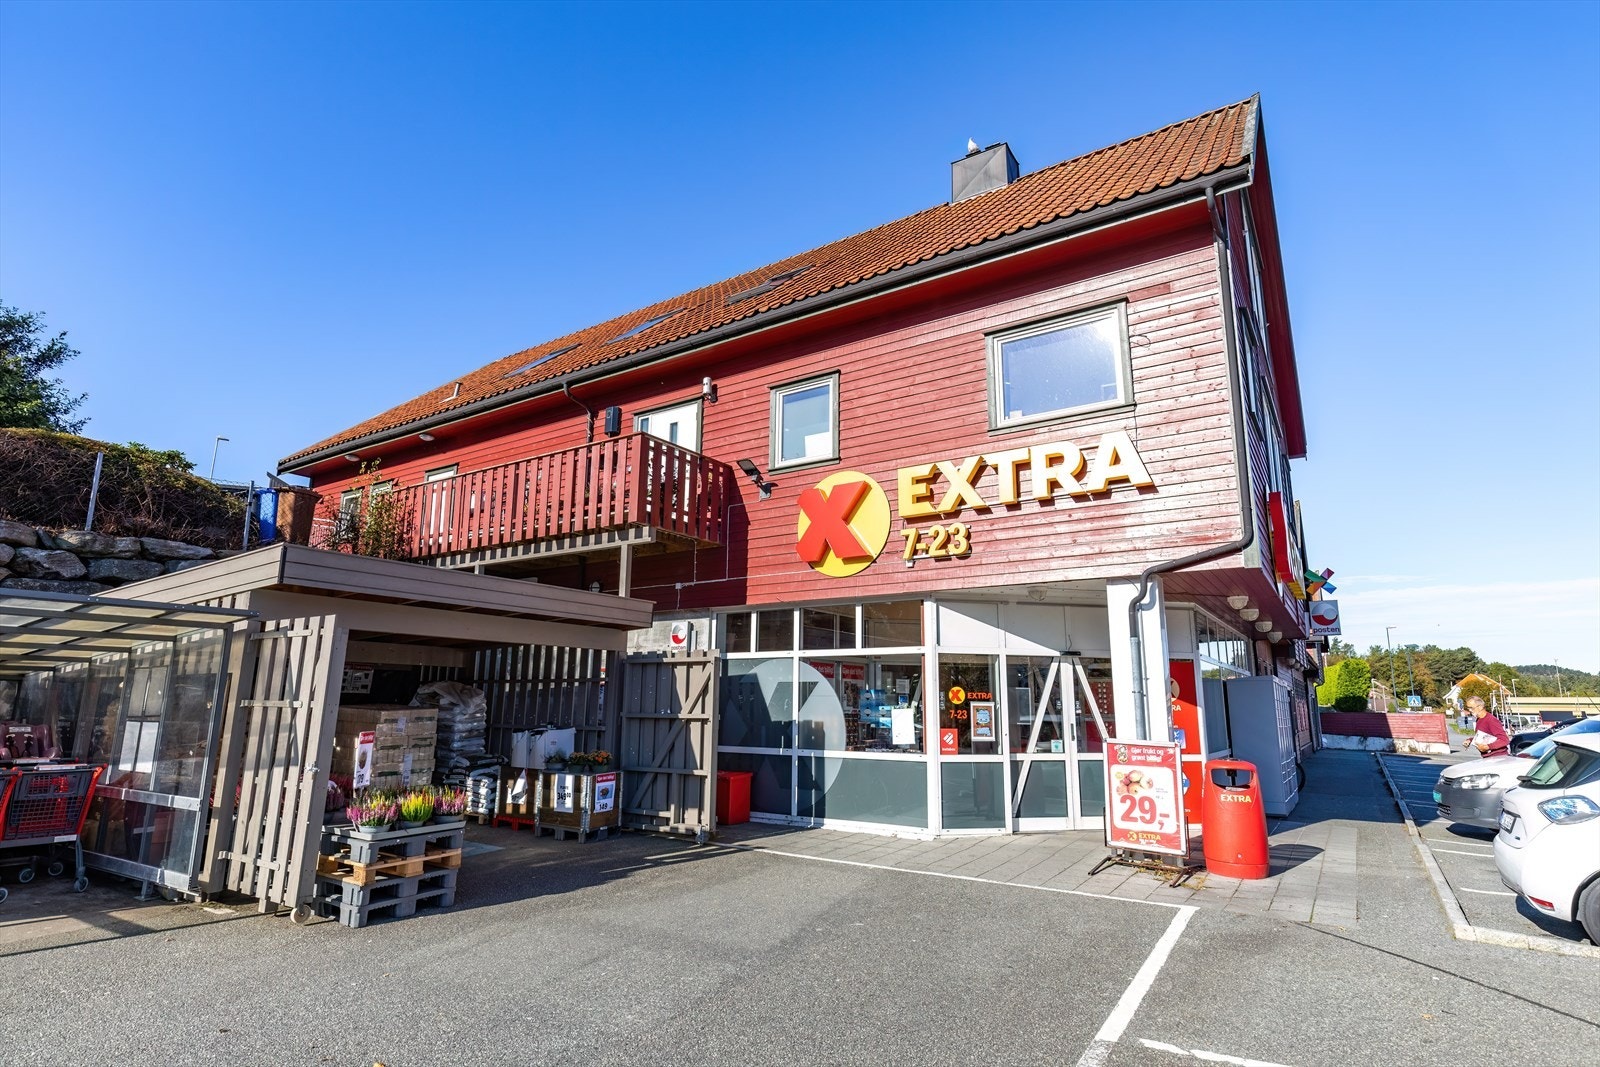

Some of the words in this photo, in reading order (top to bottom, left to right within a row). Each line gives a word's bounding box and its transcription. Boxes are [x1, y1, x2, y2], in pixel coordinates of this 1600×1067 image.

[897, 430, 1155, 520] EXTRA
[900, 522, 972, 562] 7-23
[1313, 626, 1340, 634] posten
[967, 692, 993, 700] EXTRA
[949, 710, 968, 719] 7-23
[1220, 794, 1252, 803] EXTRA
[1138, 832, 1162, 841] EXTRA
